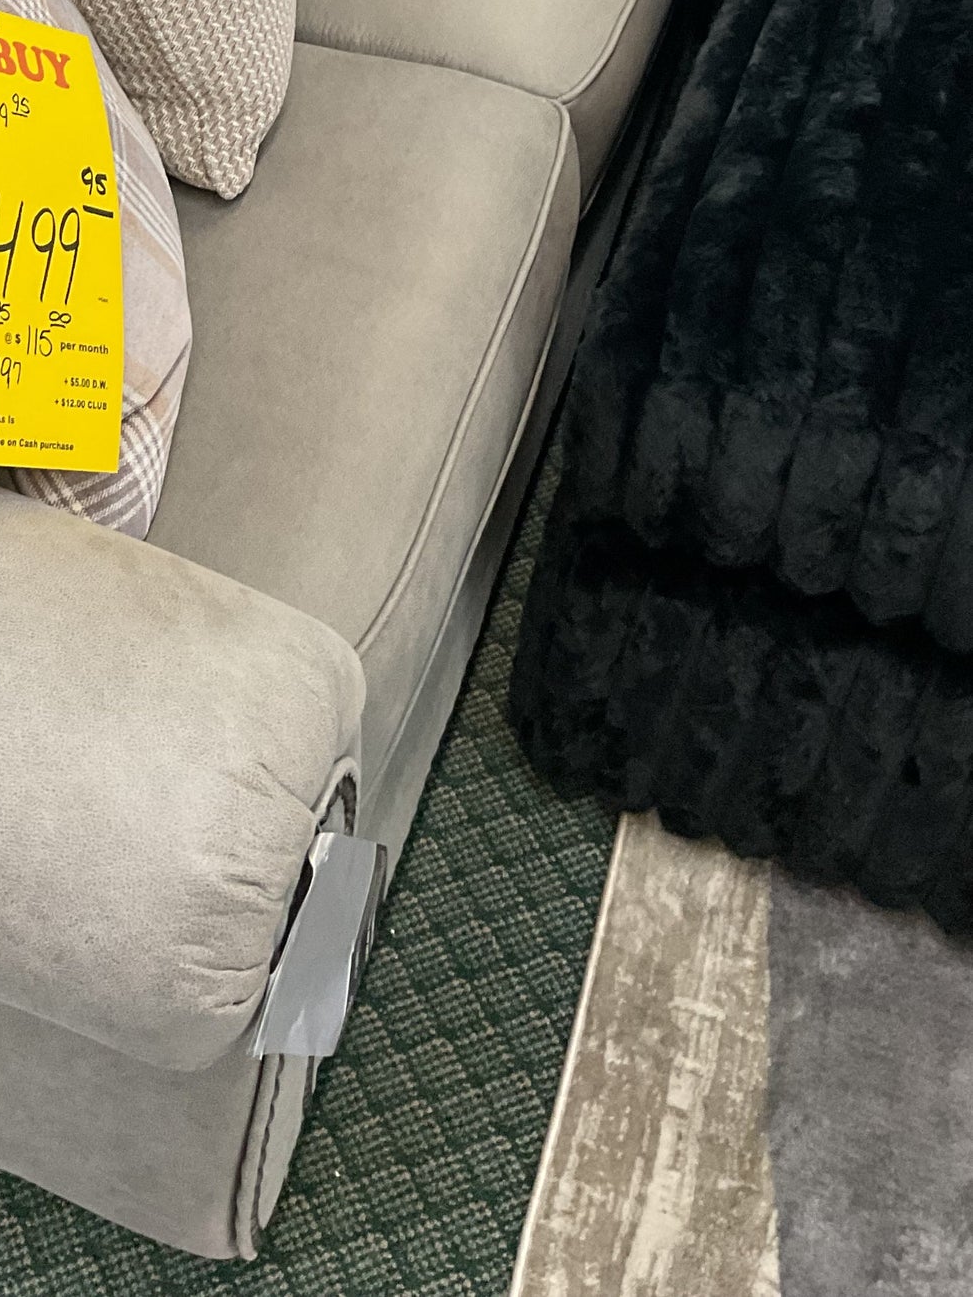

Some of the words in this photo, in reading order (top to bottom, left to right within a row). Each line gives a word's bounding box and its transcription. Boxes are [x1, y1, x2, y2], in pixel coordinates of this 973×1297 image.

[60, 341, 76, 352] per
[78, 344, 109, 355] month
[87, 400, 108, 411] CLUB
[7, 439, 17, 447] on
[19, 438, 38, 449] Cash
[39, 441, 74, 451] purchase
